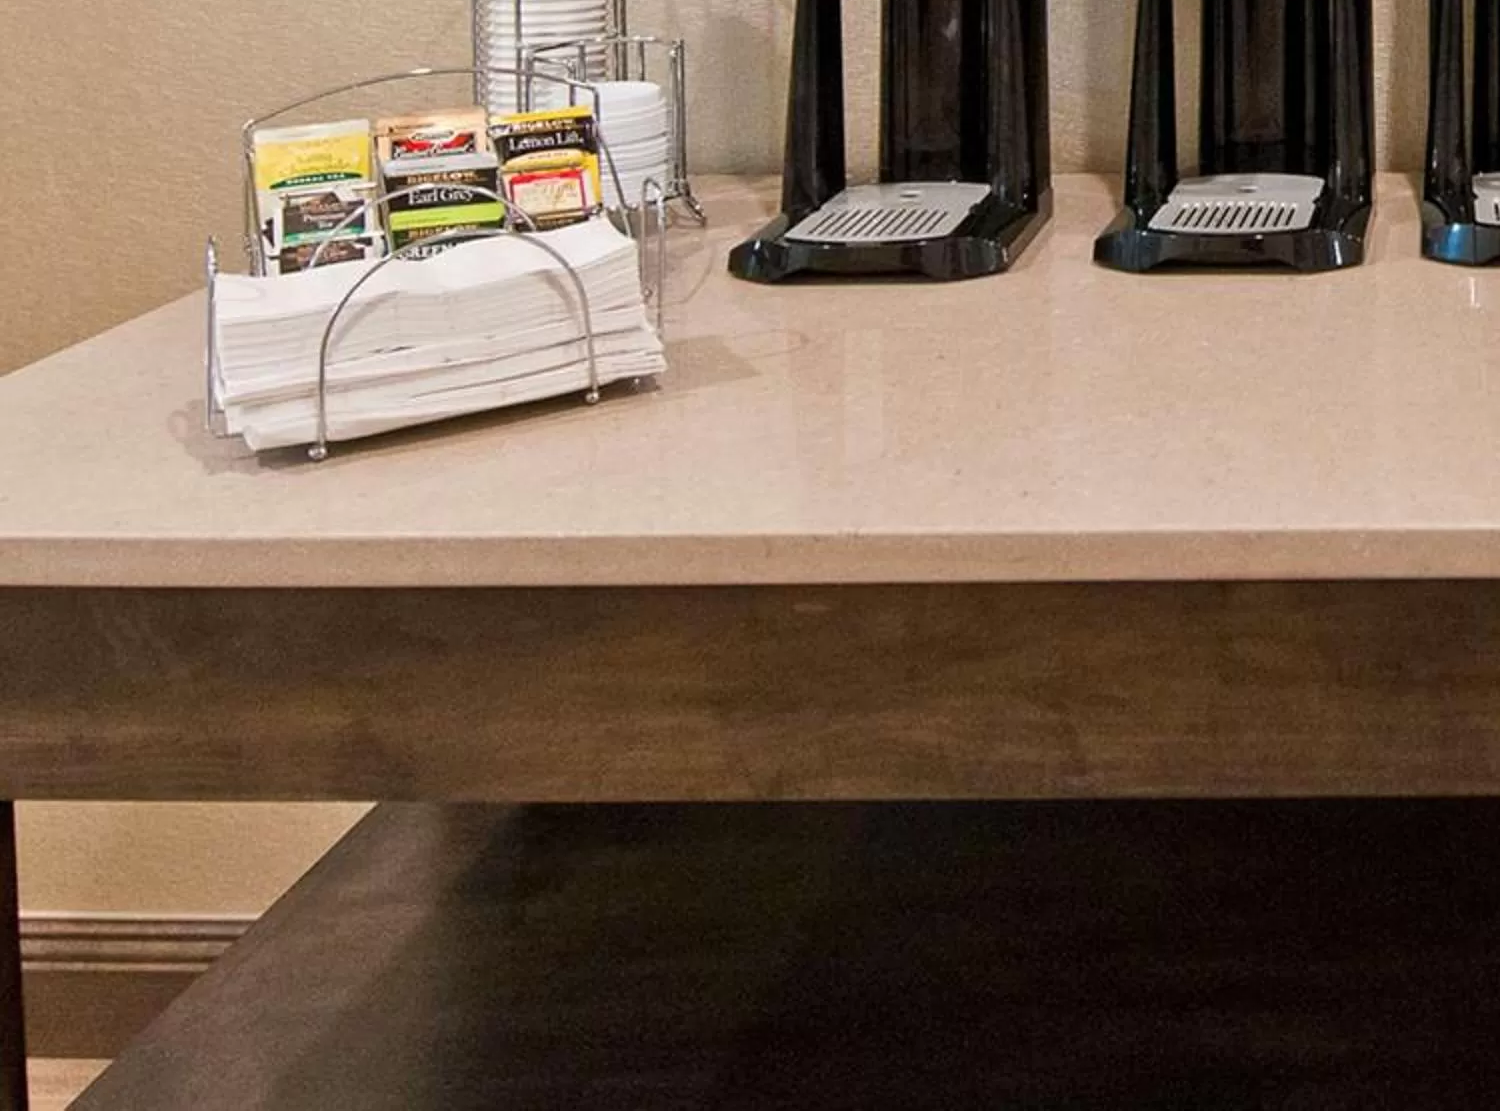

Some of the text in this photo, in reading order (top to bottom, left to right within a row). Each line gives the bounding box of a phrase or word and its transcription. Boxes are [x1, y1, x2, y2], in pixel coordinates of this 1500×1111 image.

[508, 135, 555, 151] Lemon
[408, 187, 474, 206] Earl Grey
